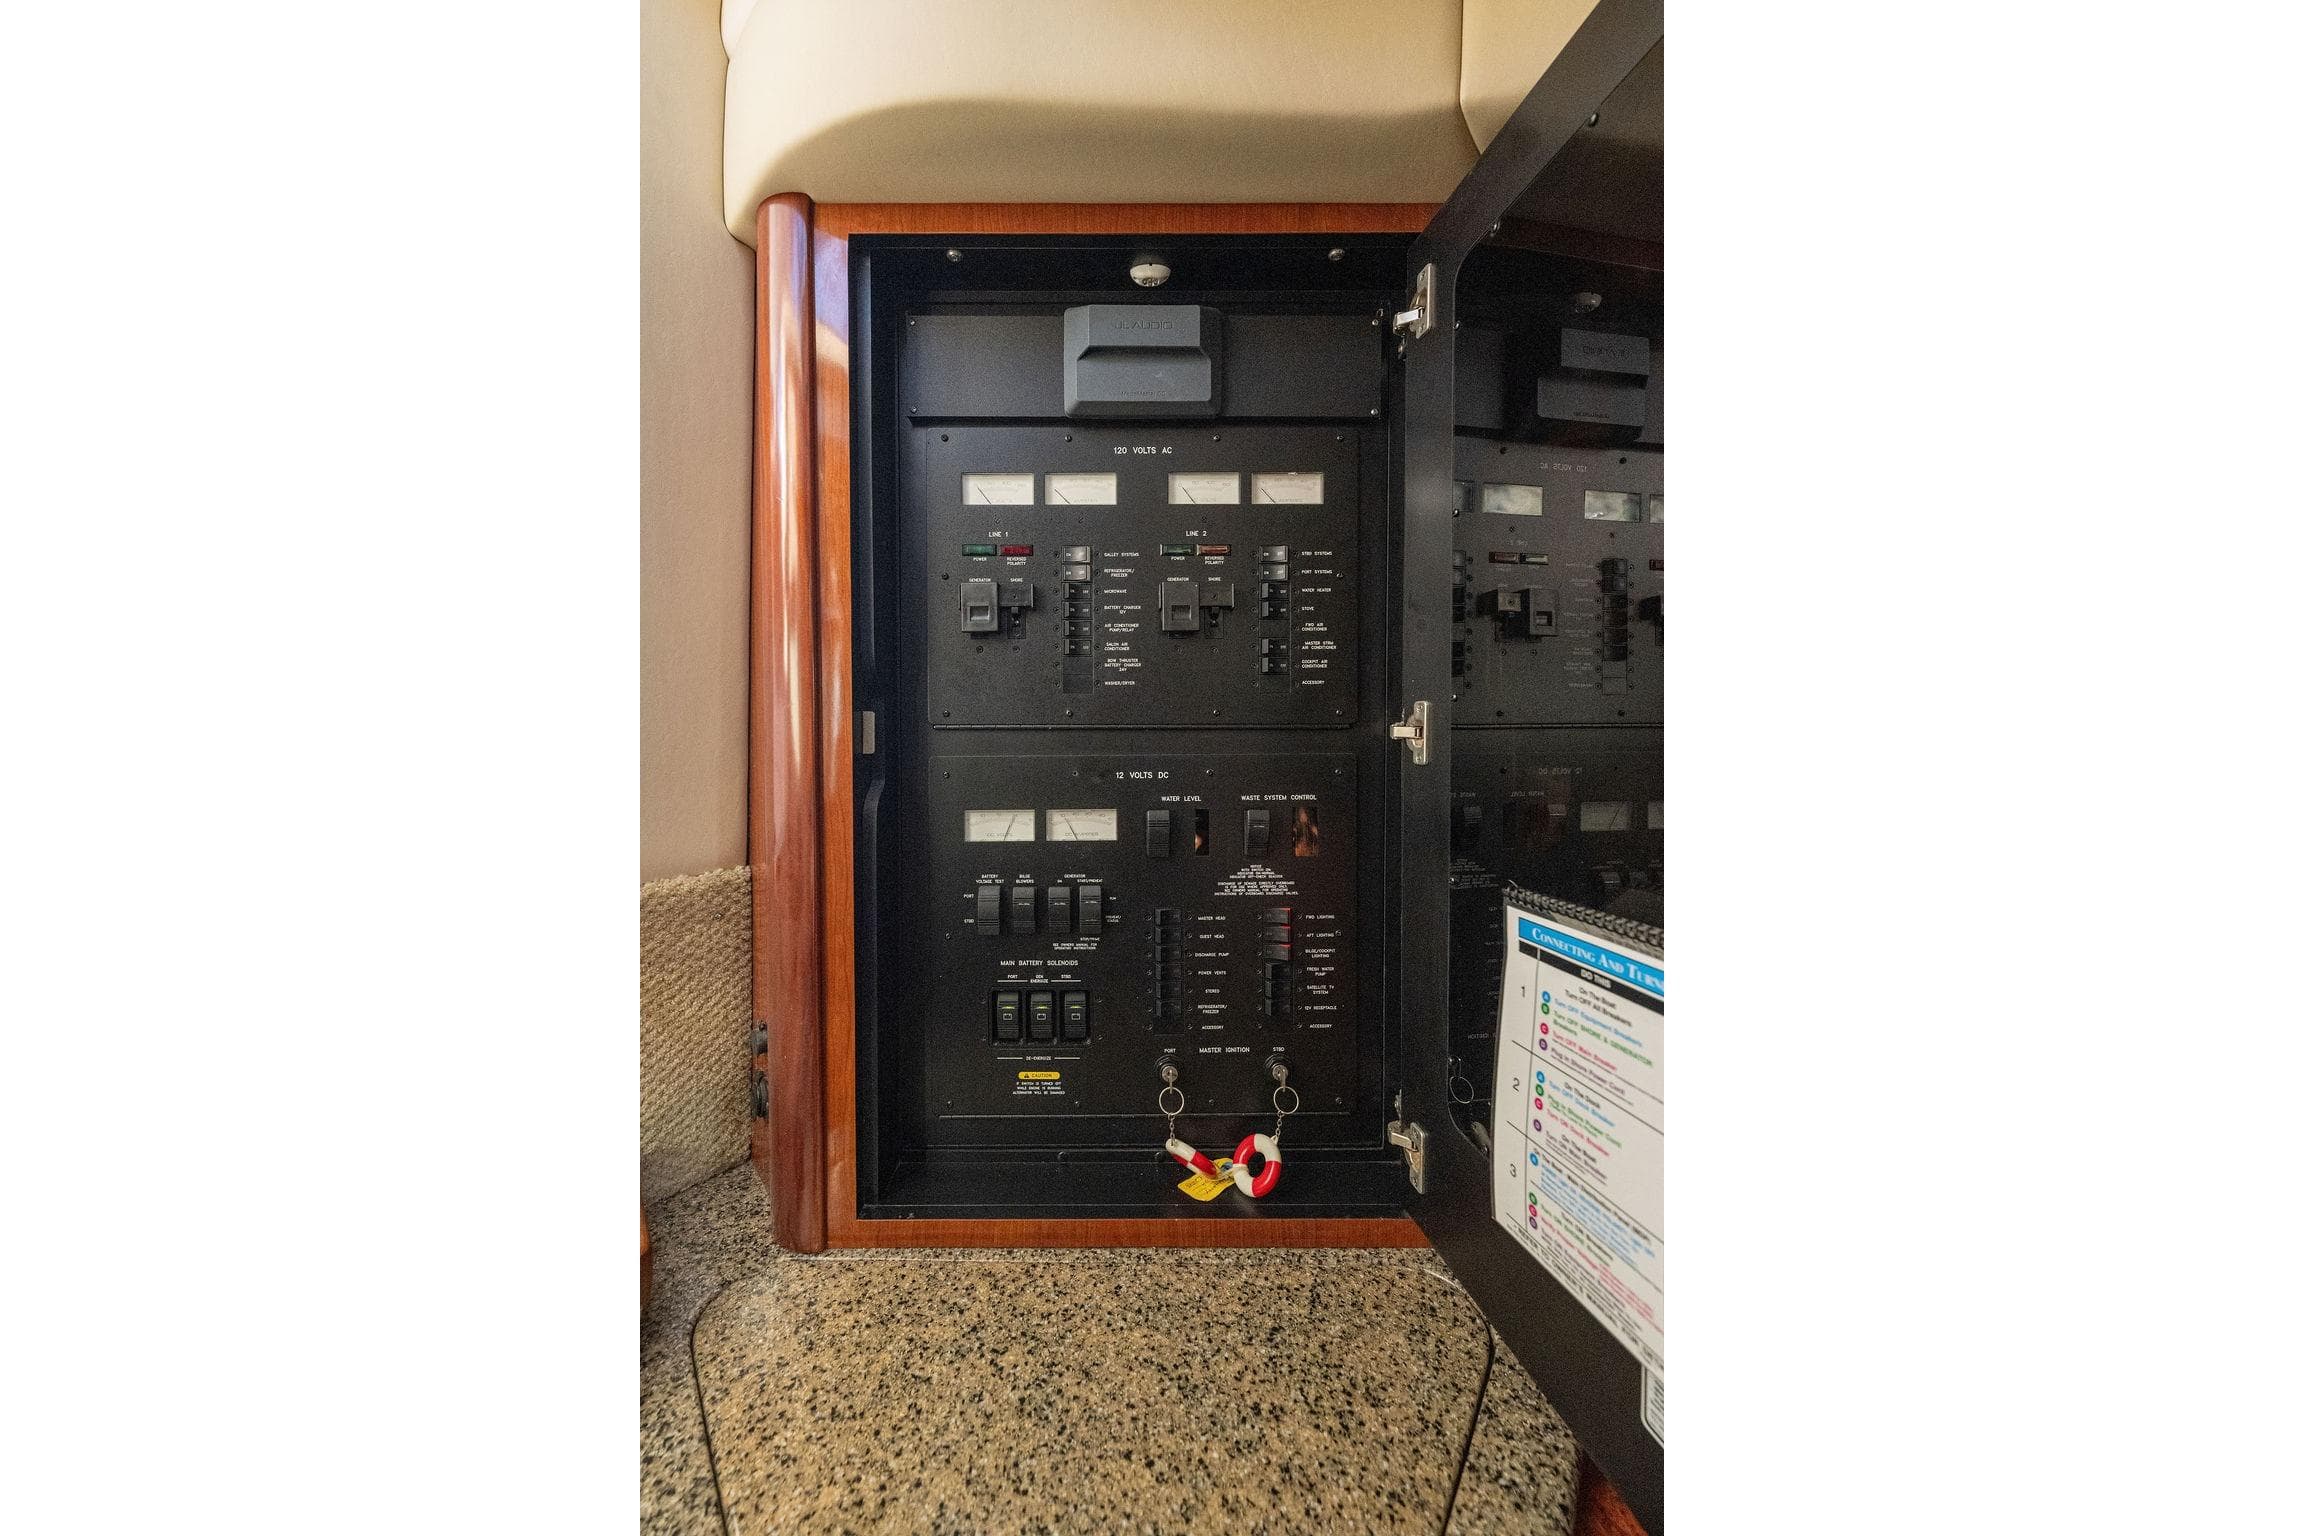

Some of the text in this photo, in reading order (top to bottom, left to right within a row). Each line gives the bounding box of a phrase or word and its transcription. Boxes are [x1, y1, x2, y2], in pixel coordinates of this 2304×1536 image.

[1113, 446, 1173, 454] 120 VOLTS AC
[1115, 771, 1169, 779] 12 VOLTS DC
[1580, 969, 1612, 988] DO THIS
[1520, 985, 1526, 998] 1
[1579, 995, 1593, 1007] OFF
[1610, 1039, 1653, 1067] GENERATOR
[1512, 1077, 1520, 1092] 2
[1509, 1163, 1517, 1178] 3
